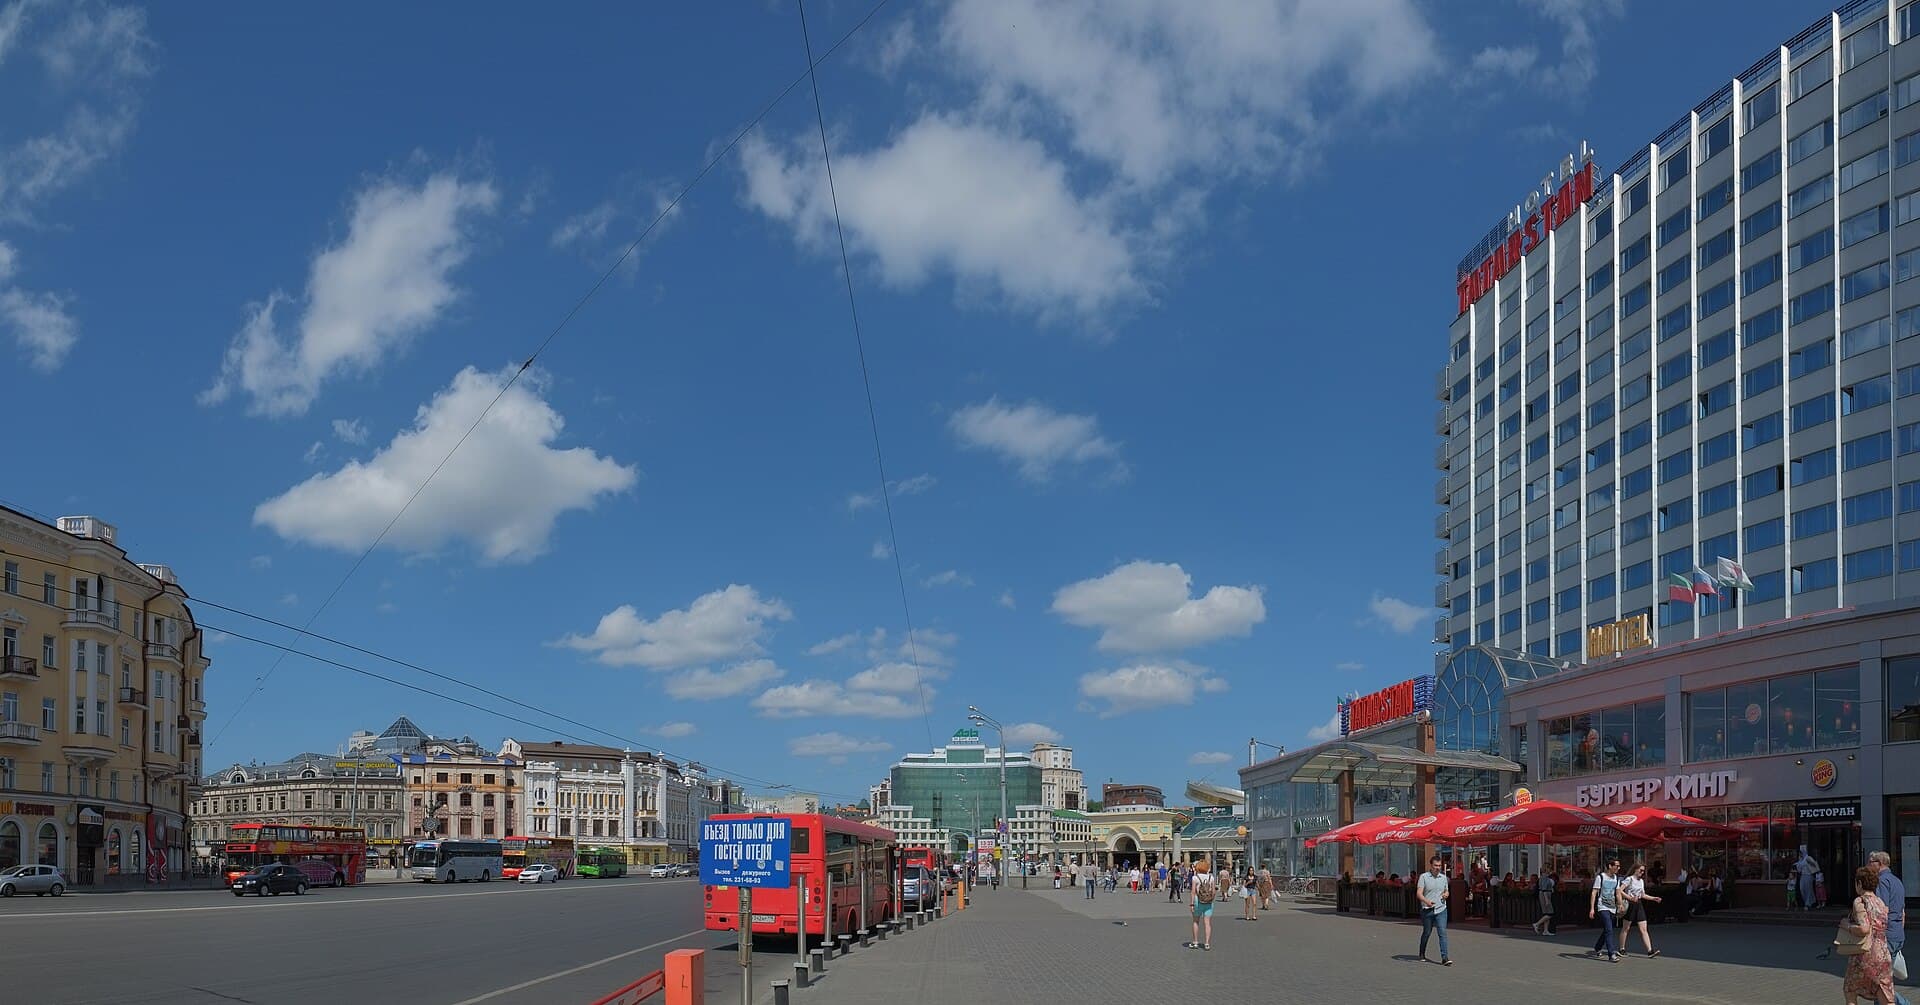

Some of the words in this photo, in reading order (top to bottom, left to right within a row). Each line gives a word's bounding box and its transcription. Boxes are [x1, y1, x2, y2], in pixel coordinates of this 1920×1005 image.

[1508, 139, 1595, 233] HOTEL
[1456, 161, 1594, 315] TATARSTAN
[1350, 679, 1414, 731] TATARSTAN
[1576, 778, 1662, 808] БУРГЕР
[1664, 769, 1738, 801] КИНГ
[1813, 768, 1833, 784] KING
[1799, 807, 1856, 818] РЕСТОРАН
[704, 824, 729, 842] ВЪЕЗД
[732, 823, 764, 840] ТОЛЬКО
[766, 822, 785, 842] ДЛЯ
[714, 841, 743, 860] ГОСТЕЙ
[745, 844, 772, 860] ОТЕЛЯ
